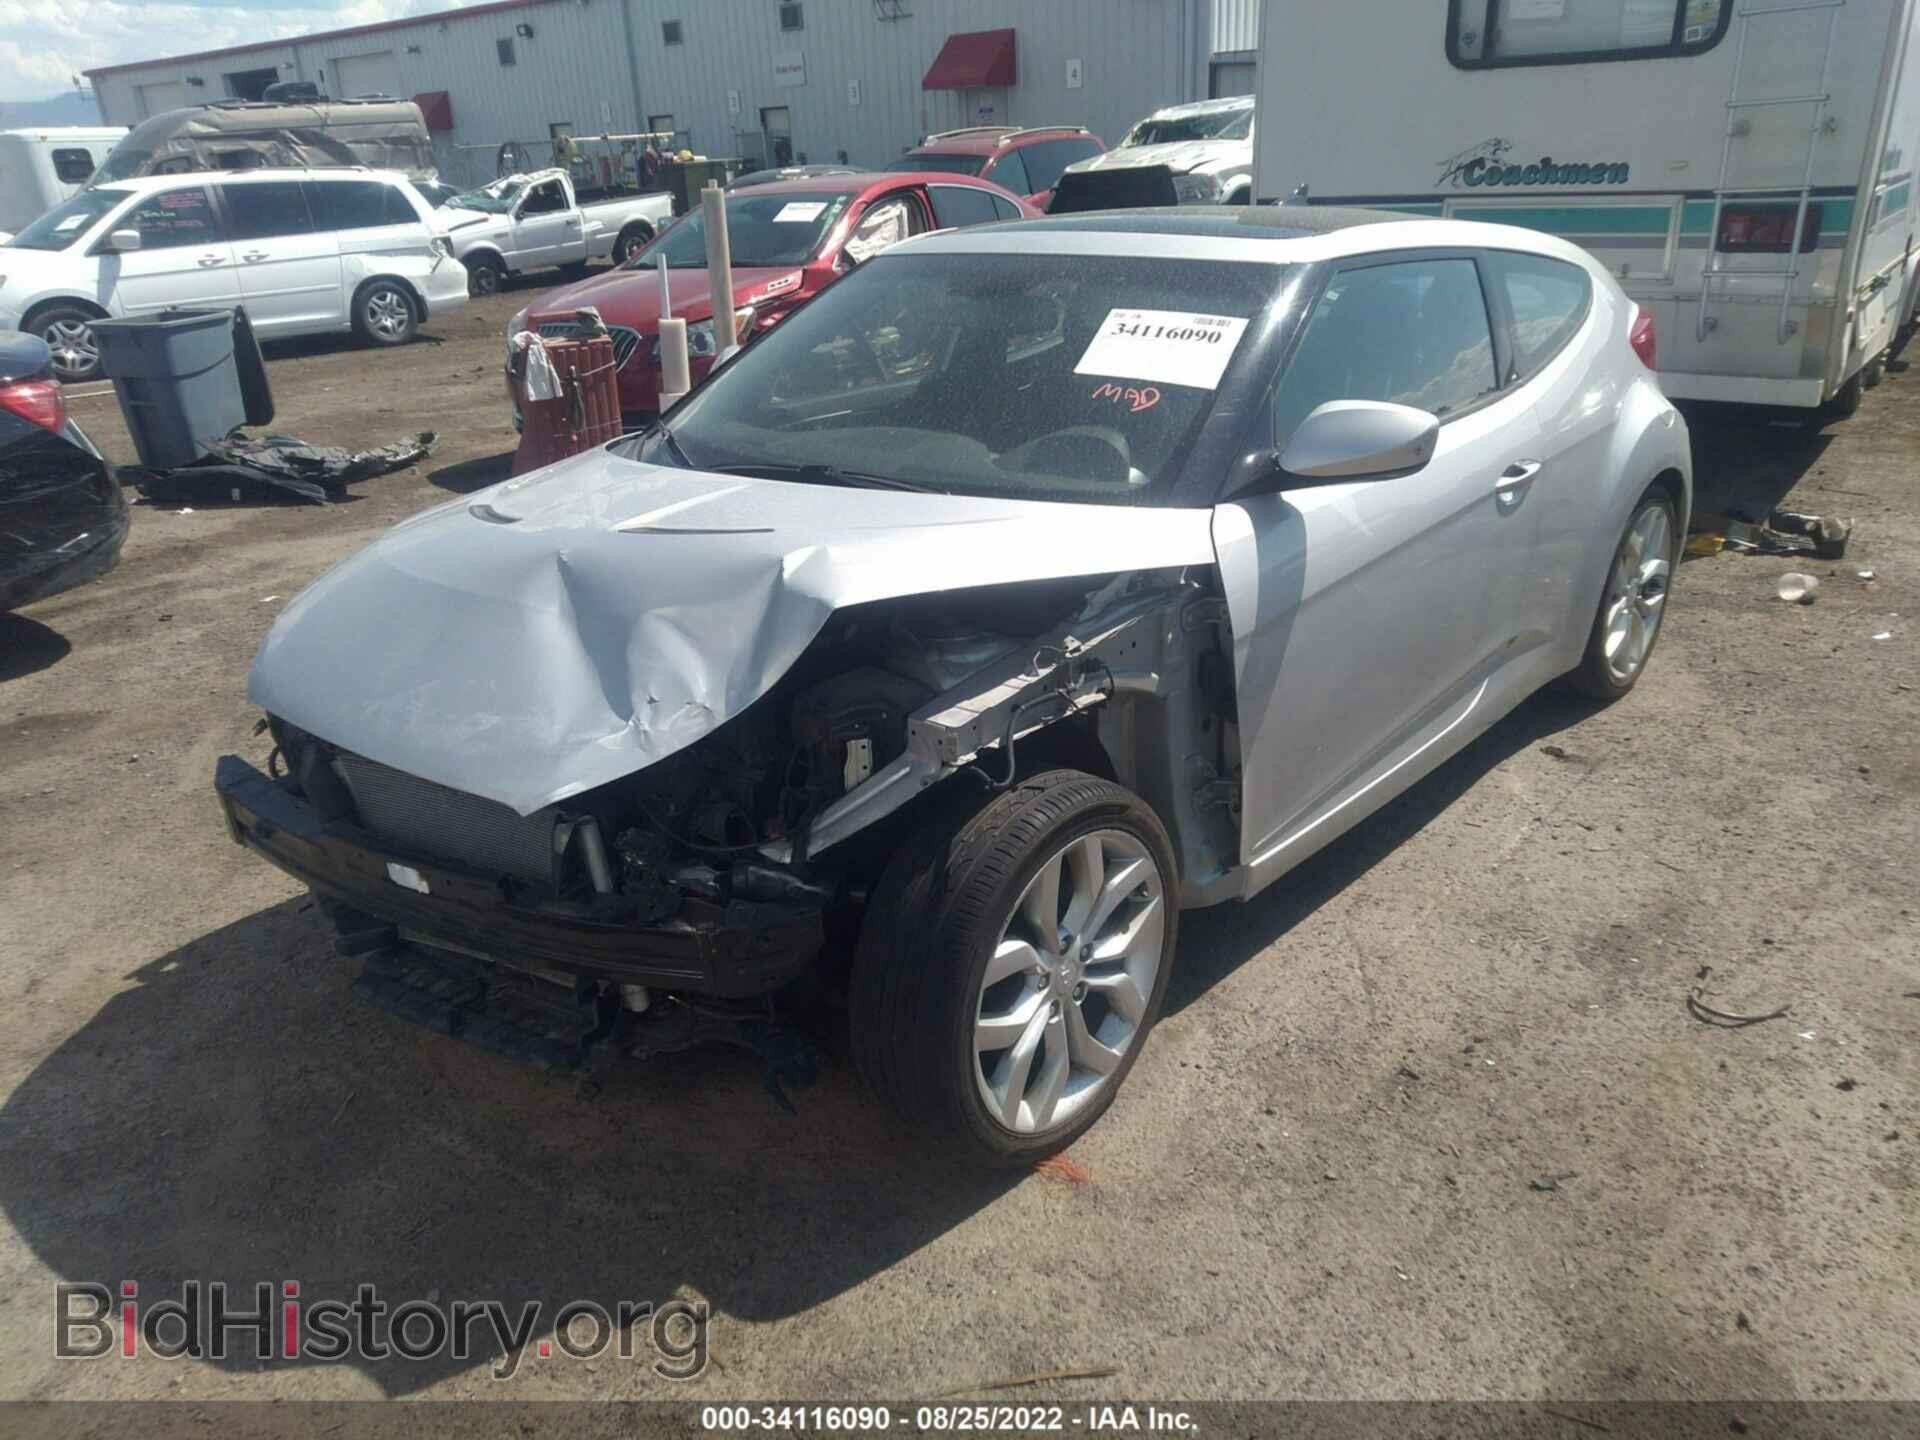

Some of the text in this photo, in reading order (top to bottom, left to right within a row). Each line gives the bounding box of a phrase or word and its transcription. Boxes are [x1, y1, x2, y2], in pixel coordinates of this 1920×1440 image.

[1070, 67, 1078, 80] 4
[1463, 156, 1630, 187] Coachmen
[1111, 322, 1222, 344] 34116090
